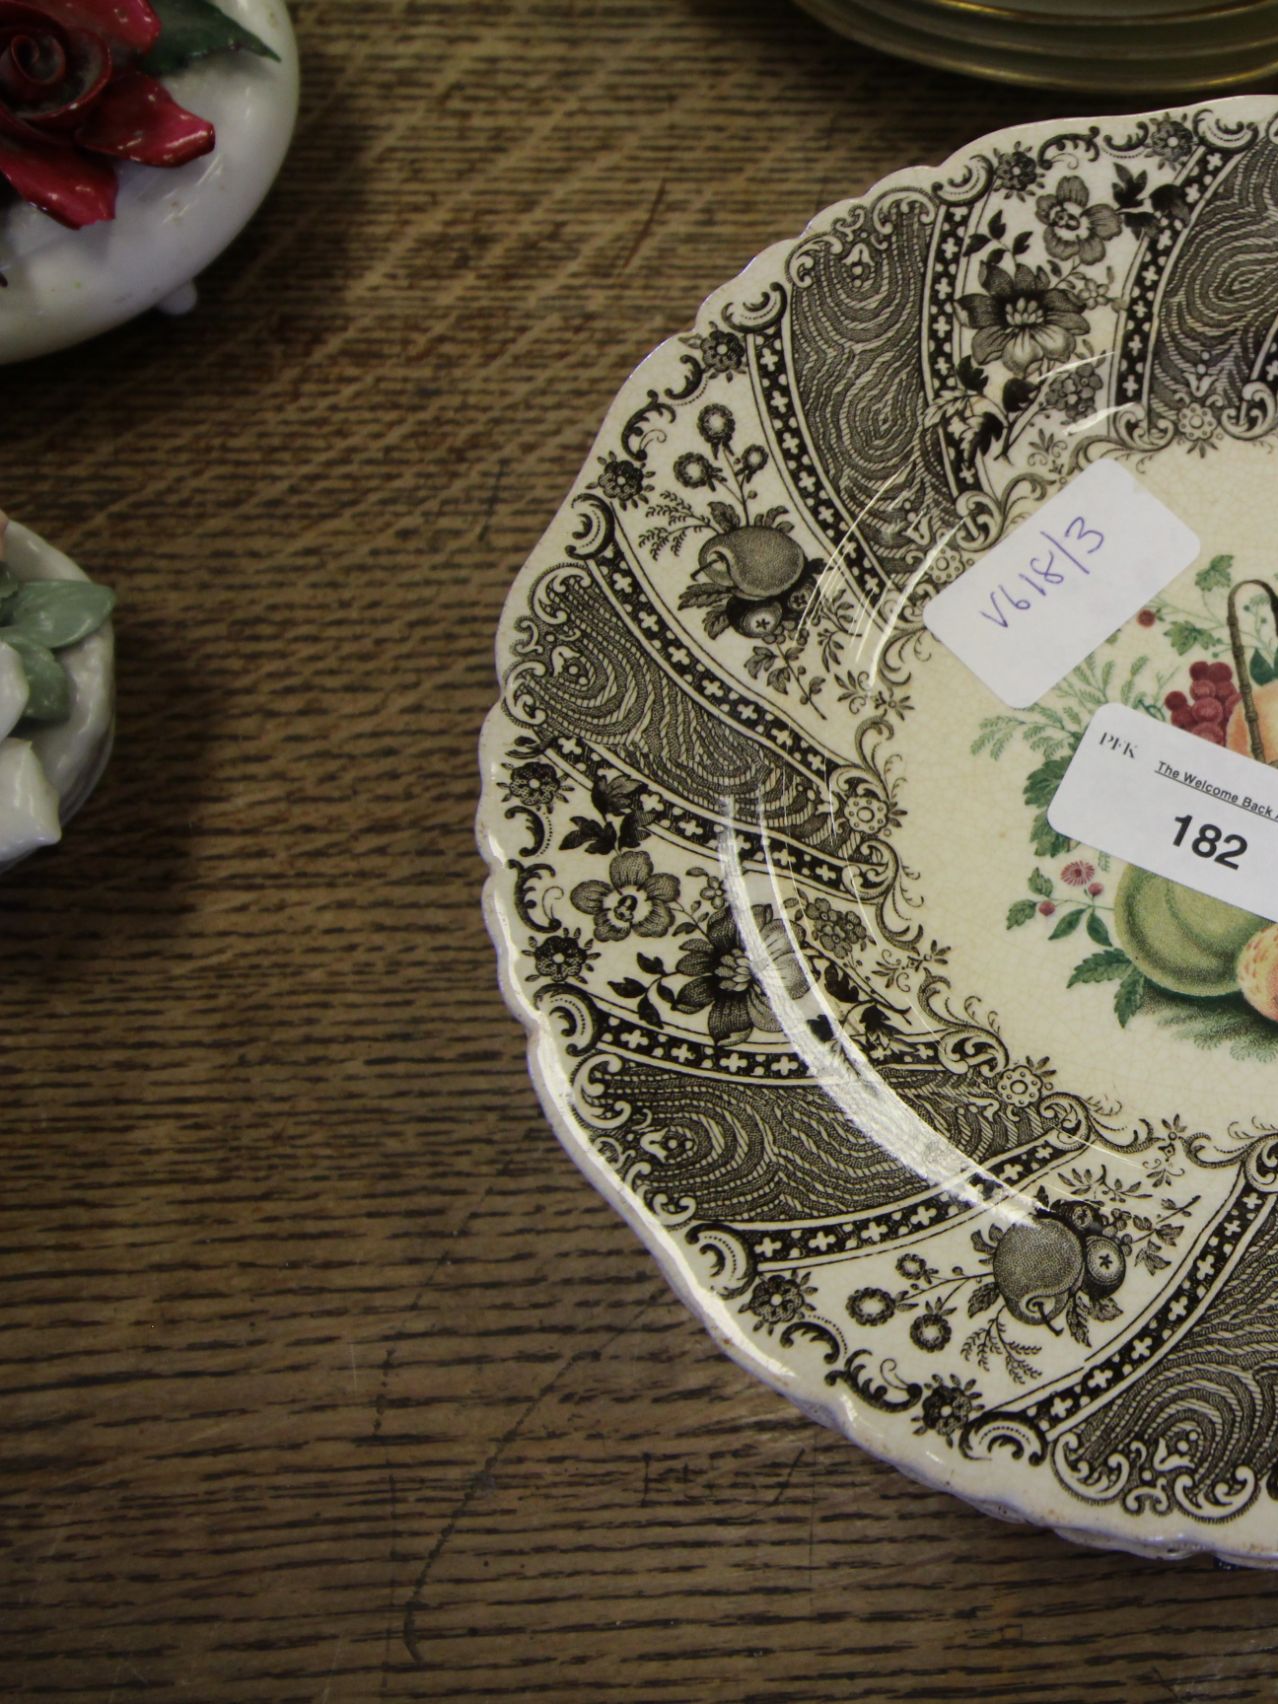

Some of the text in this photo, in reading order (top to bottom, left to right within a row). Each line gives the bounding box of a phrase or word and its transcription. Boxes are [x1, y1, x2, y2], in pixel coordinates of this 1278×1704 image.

[1156, 760, 1181, 780] The
[1182, 771, 1239, 804] Welcome
[1242, 796, 1274, 818] Back
[1172, 814, 1248, 870] 182
